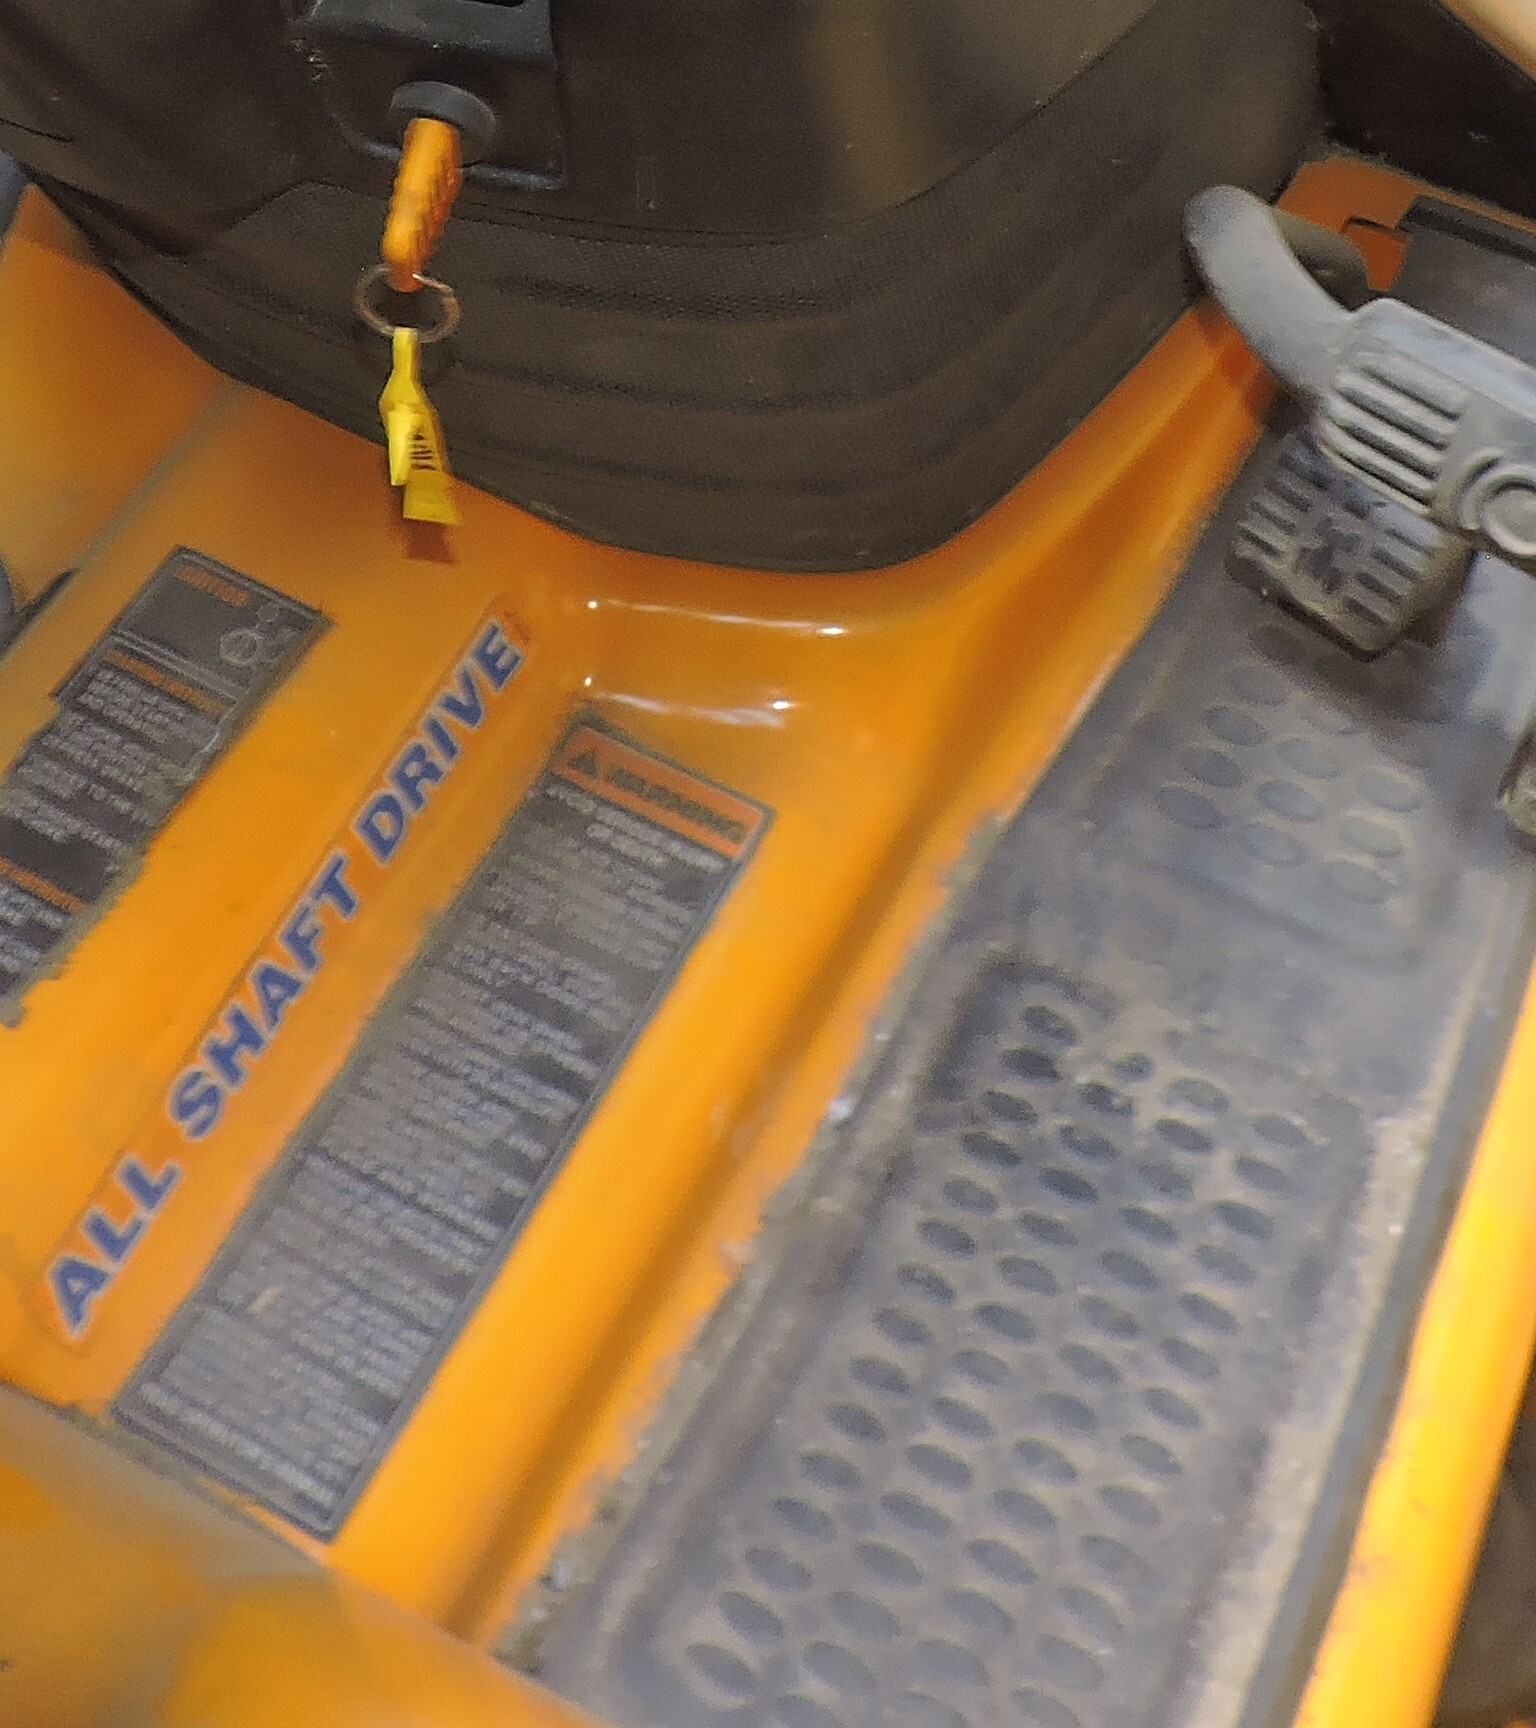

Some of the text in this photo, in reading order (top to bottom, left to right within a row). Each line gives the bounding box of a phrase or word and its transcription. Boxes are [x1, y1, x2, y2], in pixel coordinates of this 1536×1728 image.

[47, 622, 525, 1334] ALL SHAFT DRIVE
